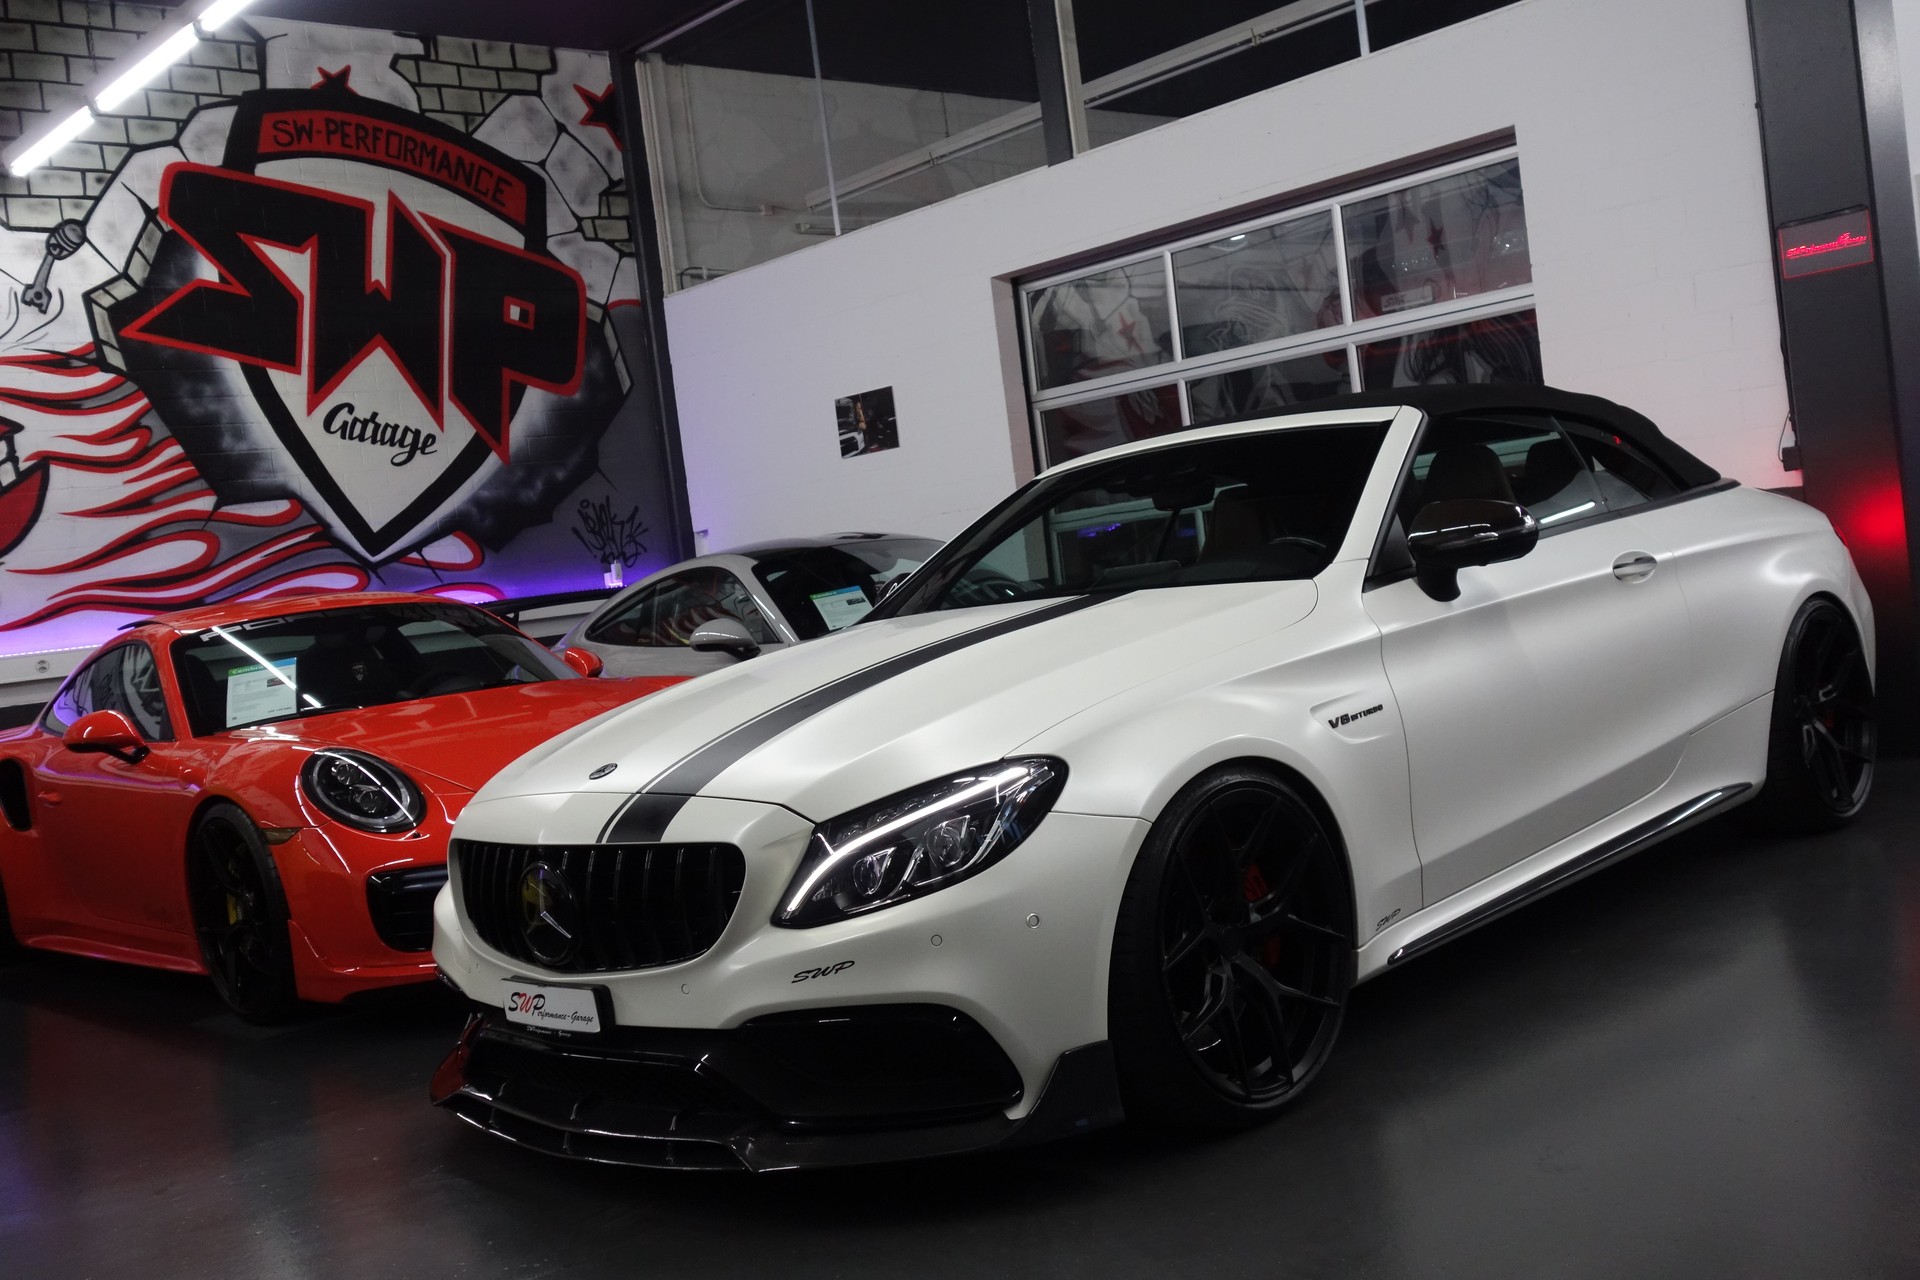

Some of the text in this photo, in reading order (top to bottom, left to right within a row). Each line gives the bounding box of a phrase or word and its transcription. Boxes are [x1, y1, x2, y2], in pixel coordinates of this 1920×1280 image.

[272, 118, 513, 207] SW-PERFORMANCE
[119, 160, 587, 465] SWP
[791, 960, 855, 984] SWP
